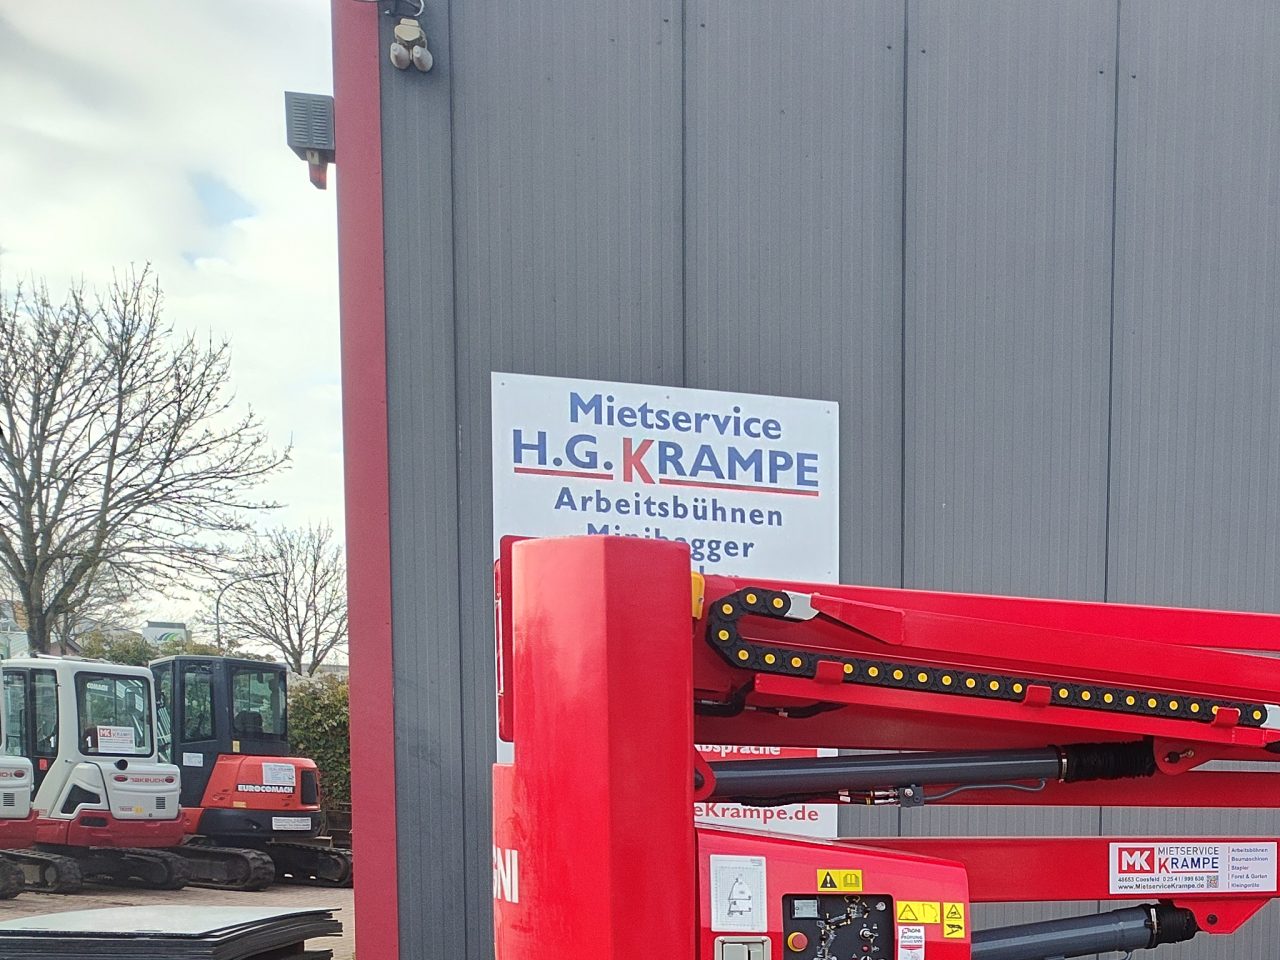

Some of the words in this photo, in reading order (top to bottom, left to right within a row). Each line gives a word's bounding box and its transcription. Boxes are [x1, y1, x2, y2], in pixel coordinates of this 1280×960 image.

[569, 391, 782, 440] Mietservice
[554, 486, 783, 527] Arbeitsbühnen
[237, 784, 294, 794] EUROCOMACH
[1158, 846, 1219, 855] MIETSERVICE
[1121, 850, 1151, 871] MK
[1158, 857, 1219, 873] KRAMPE
[1118, 882, 1205, 890] www.MietserviceKrampe.de
